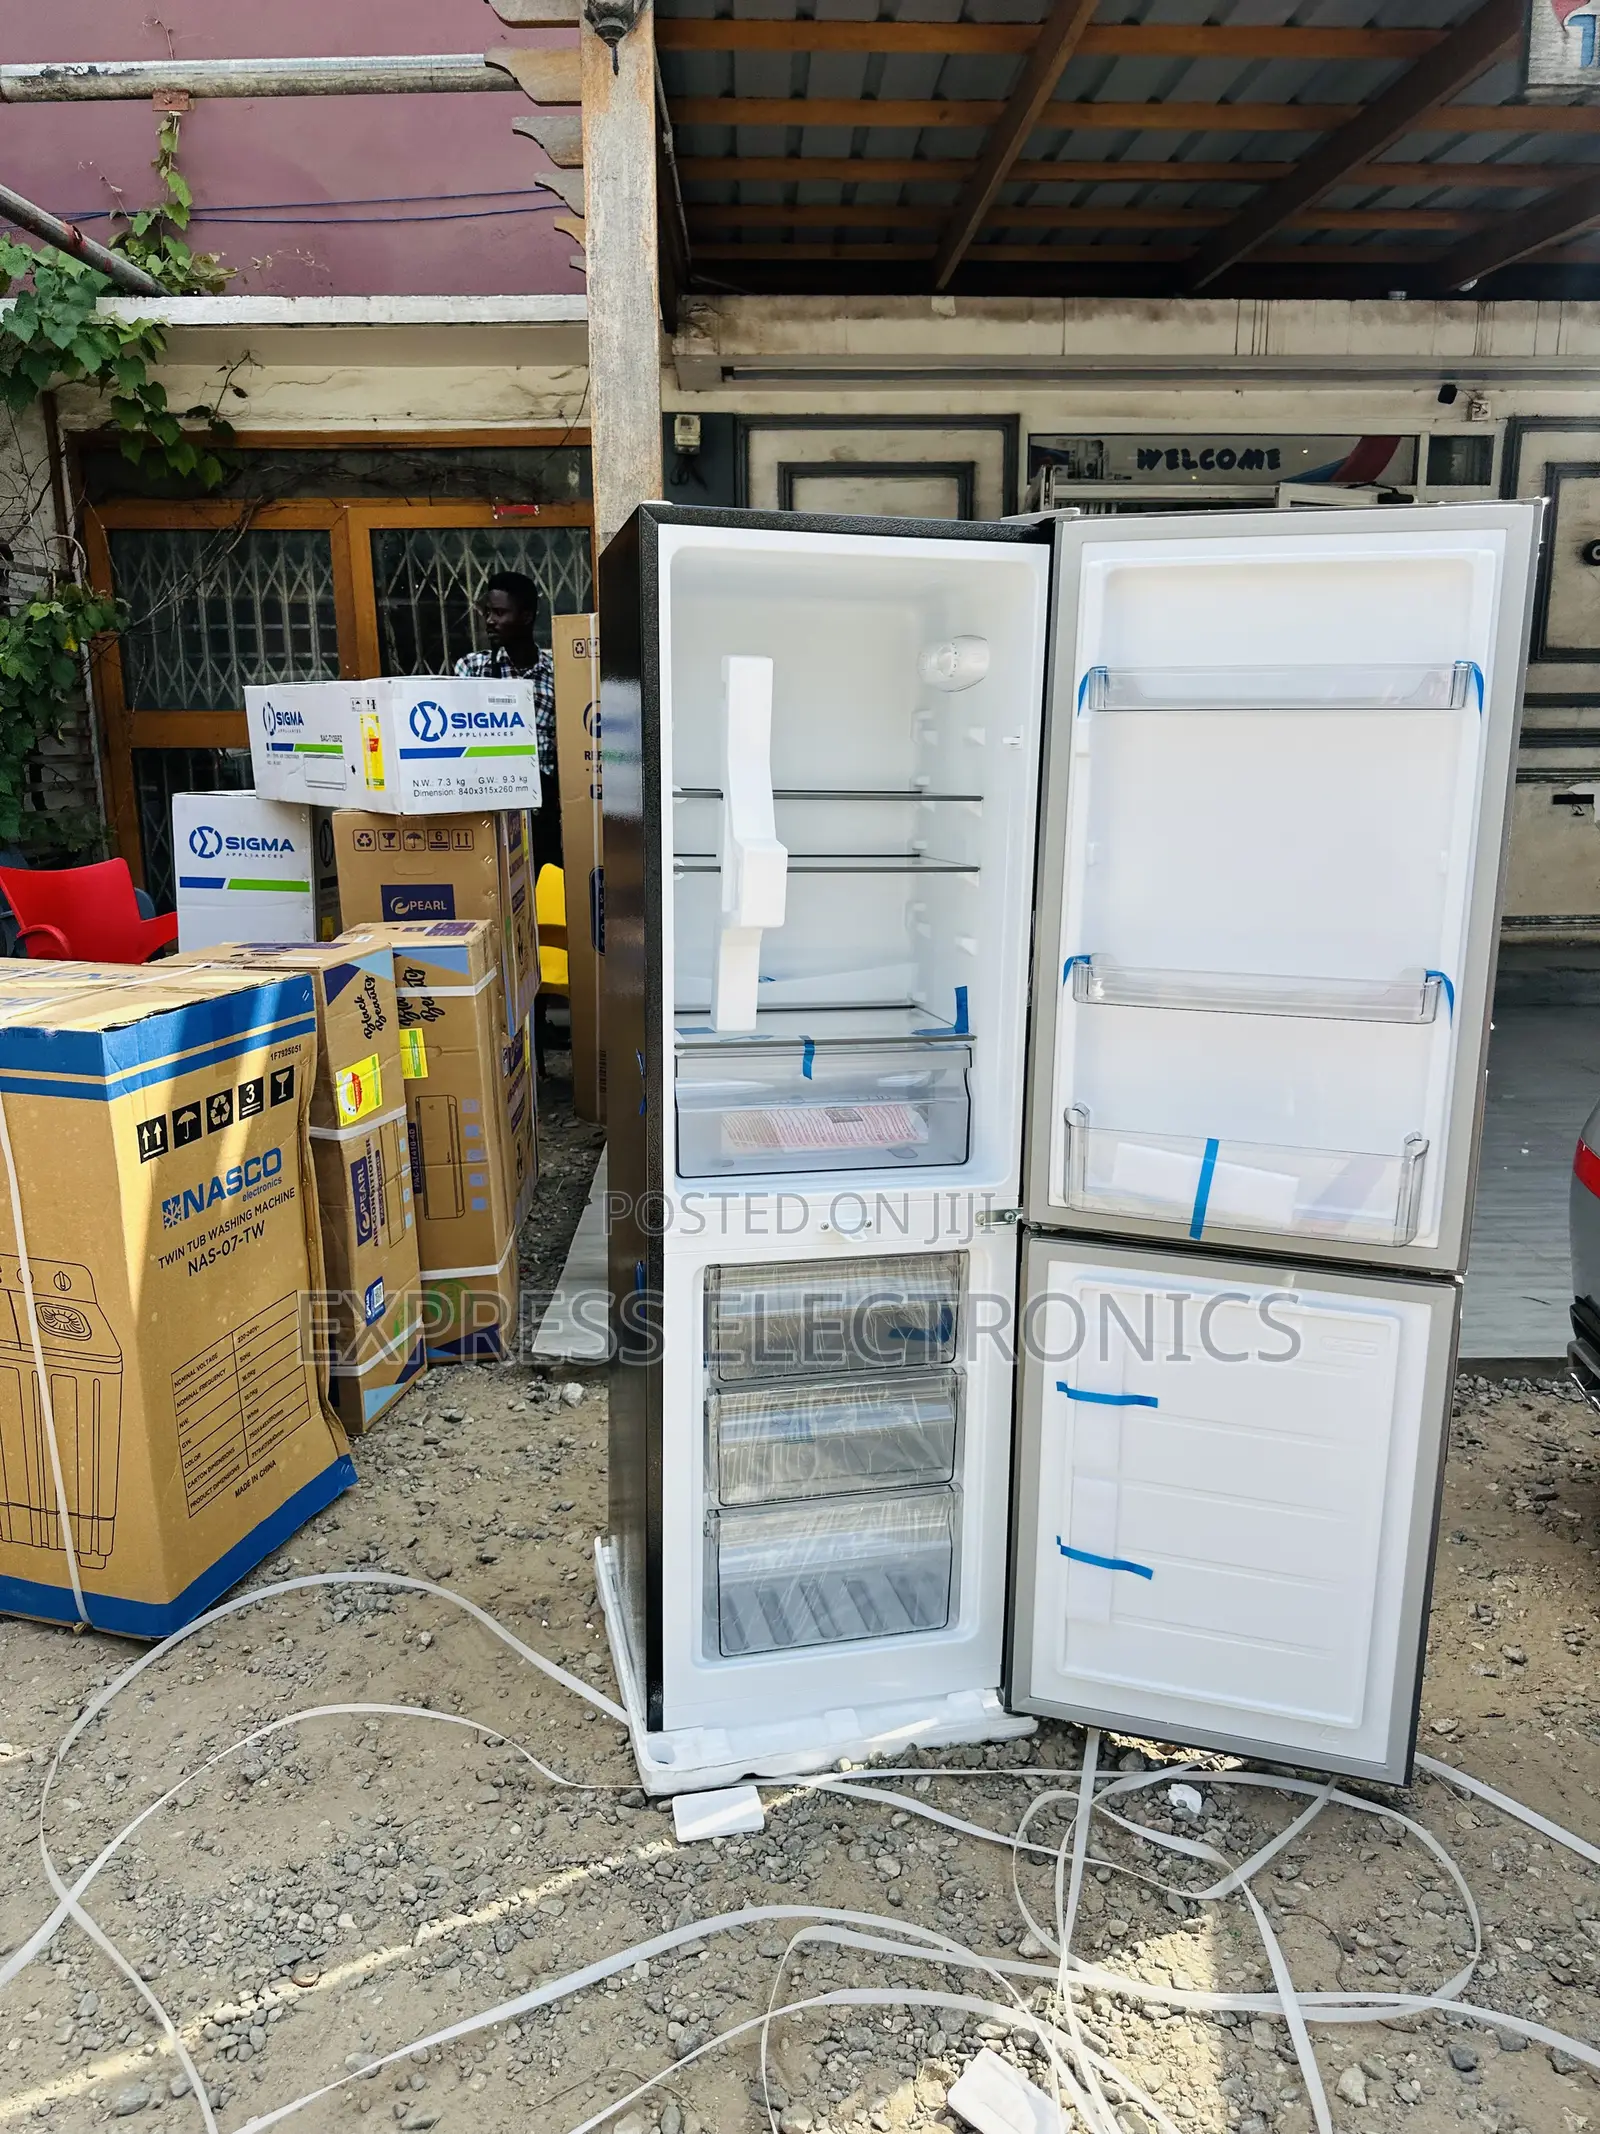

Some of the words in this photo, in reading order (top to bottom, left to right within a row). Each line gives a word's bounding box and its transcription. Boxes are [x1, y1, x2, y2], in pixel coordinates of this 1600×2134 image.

[1137, 448, 1281, 471] WELCOME
[276, 711, 305, 726] SIGMA
[450, 711, 525, 729] SIGMA
[413, 788, 456, 798] Dimension:
[458, 785, 514, 796] 840x315x260
[515, 785, 529, 793] mm
[438, 778, 452, 787] 7.3
[456, 778, 466, 787] kg
[502, 775, 516, 784] 9.3
[519, 775, 528, 784] kg
[225, 836, 295, 852] SIGMA
[435, 831, 443, 841] 6
[410, 900, 448, 911] PEARL
[354, 994, 376, 1040] Black
[364, 974, 387, 1032] Beauty
[245, 1083, 256, 1104] 3
[182, 1147, 282, 1220] NASCO
[242, 1176, 283, 1203] electronics
[357, 1164, 367, 1213] PEARL
[158, 1245, 185, 1269] TWIN
[187, 1234, 206, 1253] TUB
[208, 1209, 253, 1241] WASHING
[254, 1187, 296, 1217] MACHINE
[187, 1219, 266, 1277] NAS-07-TW
[174, 1369, 197, 1388] NOMINAL
[197, 1352, 219, 1371] VOLTAGE
[176, 1390, 199, 1409] NOMINAL
[199, 1368, 227, 1391] FREQUENCY
[184, 1453, 201, 1469] COLOR
[187, 1470, 208, 1489] CARTON
[208, 1447, 235, 1473] DIMENSIONS
[190, 1487, 213, 1509] PRODUCT
[213, 1463, 241, 1491] DIMENSIONS
[235, 1481, 251, 1498] MADE
[250, 1474, 258, 1484] IN
[259, 1459, 277, 1479] CHINA
